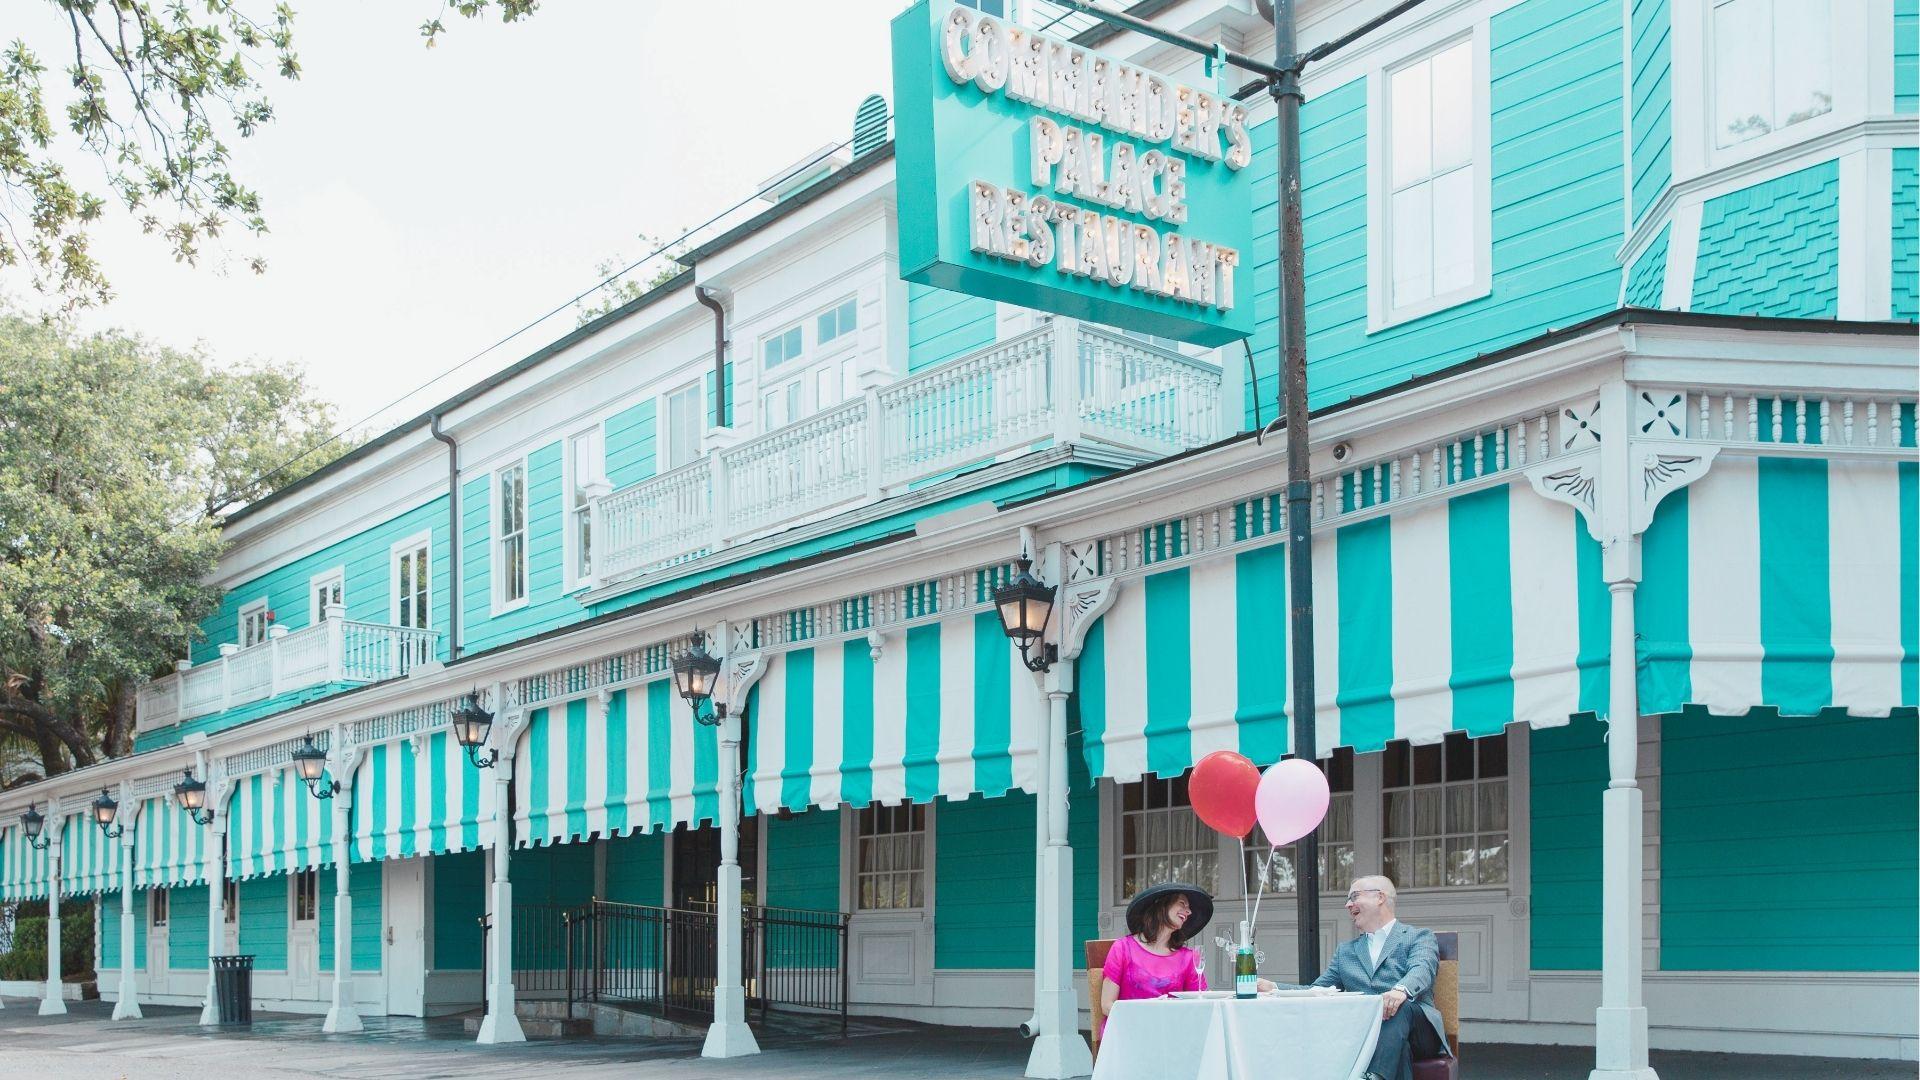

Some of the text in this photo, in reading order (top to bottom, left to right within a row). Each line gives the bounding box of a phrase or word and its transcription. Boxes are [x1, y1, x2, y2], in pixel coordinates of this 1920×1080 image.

[941, 7, 1251, 170] COMMANDER'S
[1030, 116, 1186, 223] PALACE
[970, 180, 1239, 311] RESTAURANT
